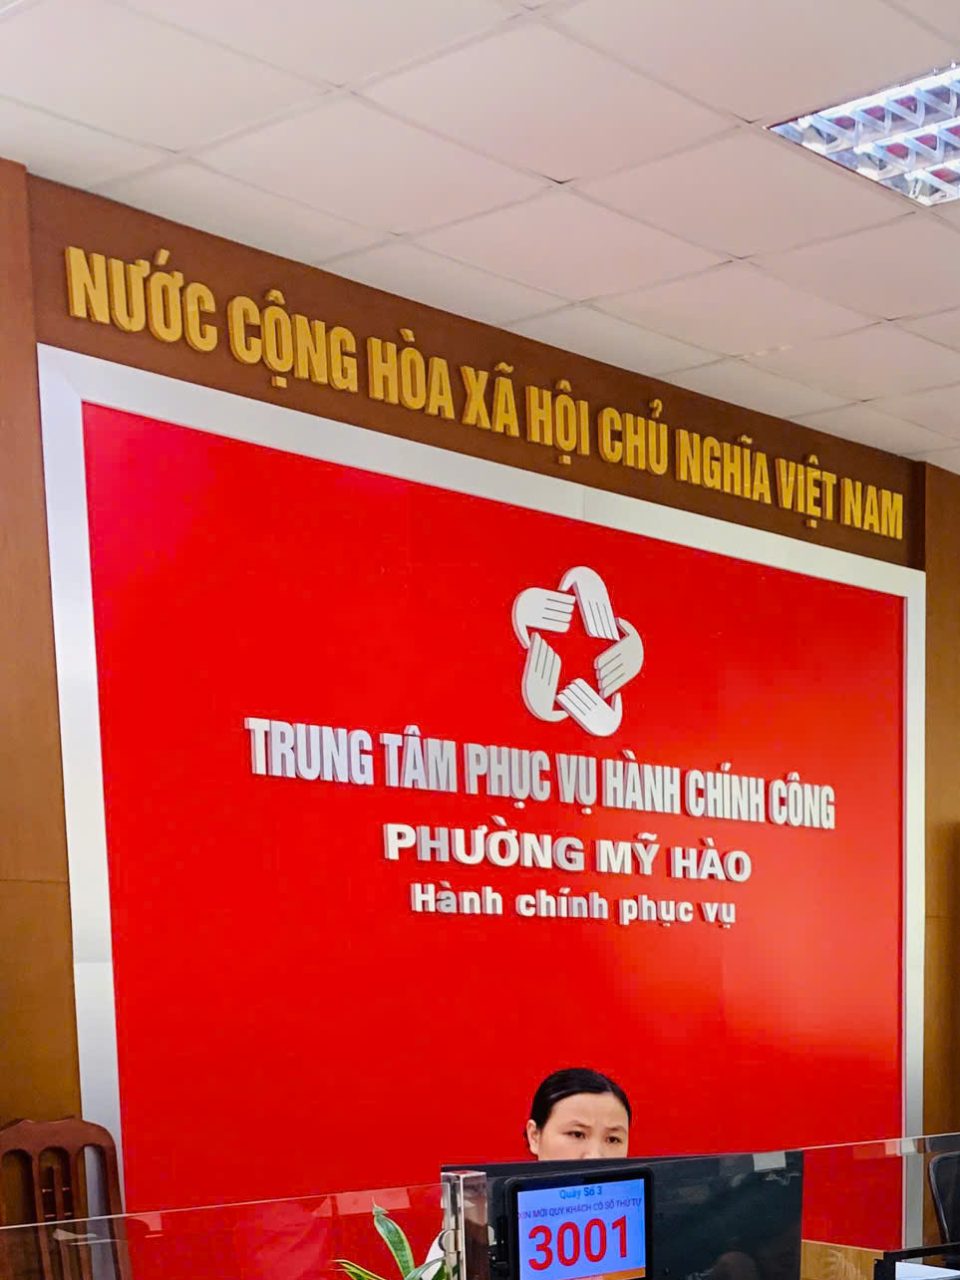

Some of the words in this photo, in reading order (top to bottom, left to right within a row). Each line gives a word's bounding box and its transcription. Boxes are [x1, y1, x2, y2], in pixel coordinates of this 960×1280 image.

[65, 247, 218, 352] NƯỚC
[228, 289, 358, 392] CỘNG
[367, 329, 455, 420] HÒA
[461, 362, 519, 437] XÃ
[526, 379, 589, 464] HỘI
[598, 399, 668, 475] CHỦ
[675, 430, 772, 504] NGHĨA
[775, 454, 836, 527] VIỆT
[841, 477, 904, 540] NAM
[245, 717, 373, 785] TRUNG
[380, 725, 457, 792] TÂM
[465, 743, 551, 809] PHỤC
[556, 753, 597, 815] VỤ
[602, 750, 680, 815] HÀNH
[686, 762, 765, 823] CHÍNH
[770, 772, 835, 829] CÔNG
[383, 815, 584, 872] PHƯỜNG
[595, 832, 660, 875] MỸ
[672, 838, 752, 882] HÀO
[411, 881, 503, 915] Hành
[515, 887, 609, 919] chính
[619, 895, 694, 927] phục
[700, 902, 736, 929] vụ
[528, 1215, 627, 1271] 3001
